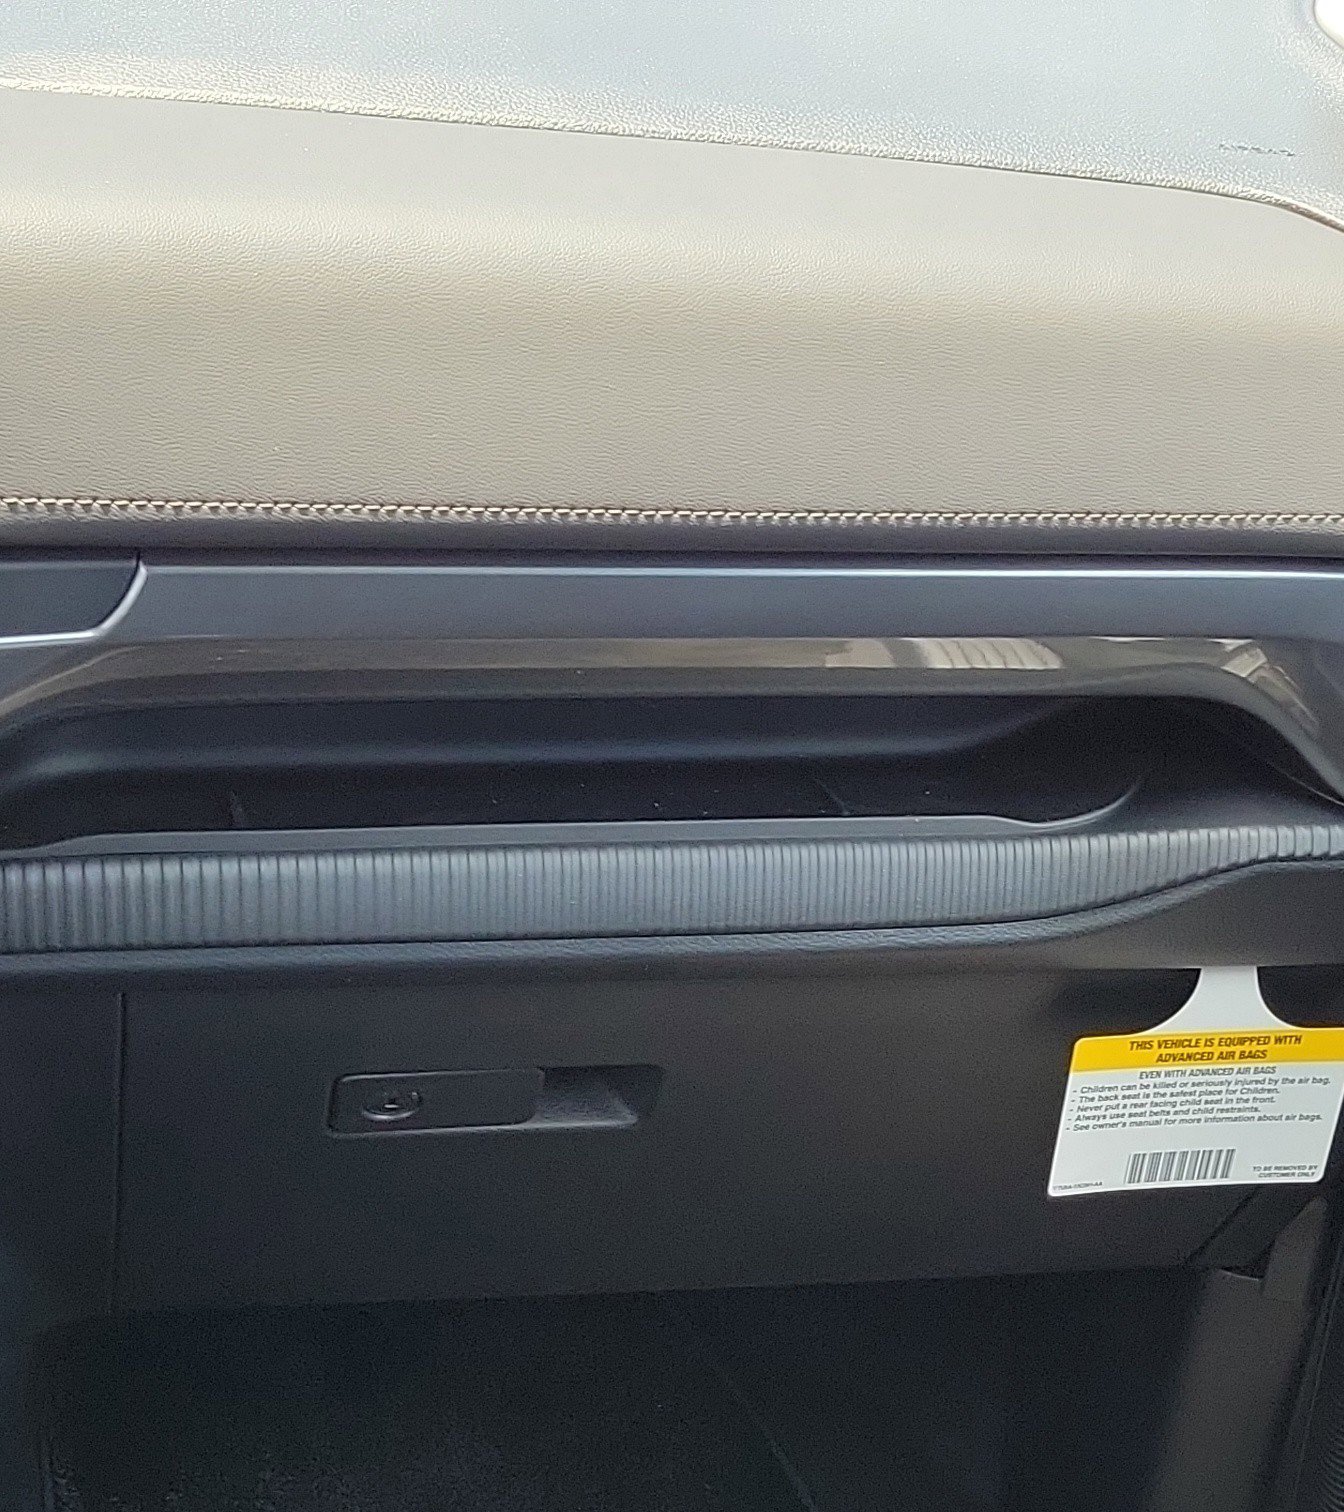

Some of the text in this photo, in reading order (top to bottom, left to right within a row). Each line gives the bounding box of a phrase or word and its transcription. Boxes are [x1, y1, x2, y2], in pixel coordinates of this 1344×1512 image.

[1130, 1035, 1302, 1051] THIS VEHICLE IS EQUIPPED WITH
[1156, 1050, 1268, 1063] ADVANCED AIR BAGS
[1139, 1066, 1276, 1080] EVEN WITH ADVANCED AIR BAGS
[1080, 1085, 1118, 1094] Children
[1153, 1081, 1176, 1089] killed
[1191, 1077, 1232, 1088] seriously
[1235, 1077, 1266, 1086] injured
[1268, 1077, 1279, 1086] by
[1282, 1076, 1295, 1084] the
[1312, 1077, 1331, 1085] bag.
[1098, 1094, 1119, 1102] back
[1169, 1089, 1196, 1098] safest
[1198, 1088, 1223, 1097] place
[1225, 1087, 1238, 1095] for
[1240, 1087, 1280, 1095] Children.
[1077, 1105, 1103, 1113] Never
[1105, 1104, 1120, 1113] put
[1150, 1100, 1177, 1109] facing
[1204, 1097, 1223, 1105] seat
[1236, 1096, 1249, 1104] the
[1075, 1113, 1106, 1122] Always
[1149, 1109, 1170, 1117] belts
[1192, 1107, 1214, 1115] child
[1092, 1121, 1126, 1129] owner's
[1129, 1119, 1161, 1127] manual
[1164, 1118, 1177, 1126] for
[1204, 1115, 1255, 1123] information
[1257, 1114, 1283, 1122] about
[1299, 1113, 1322, 1122] bags.
